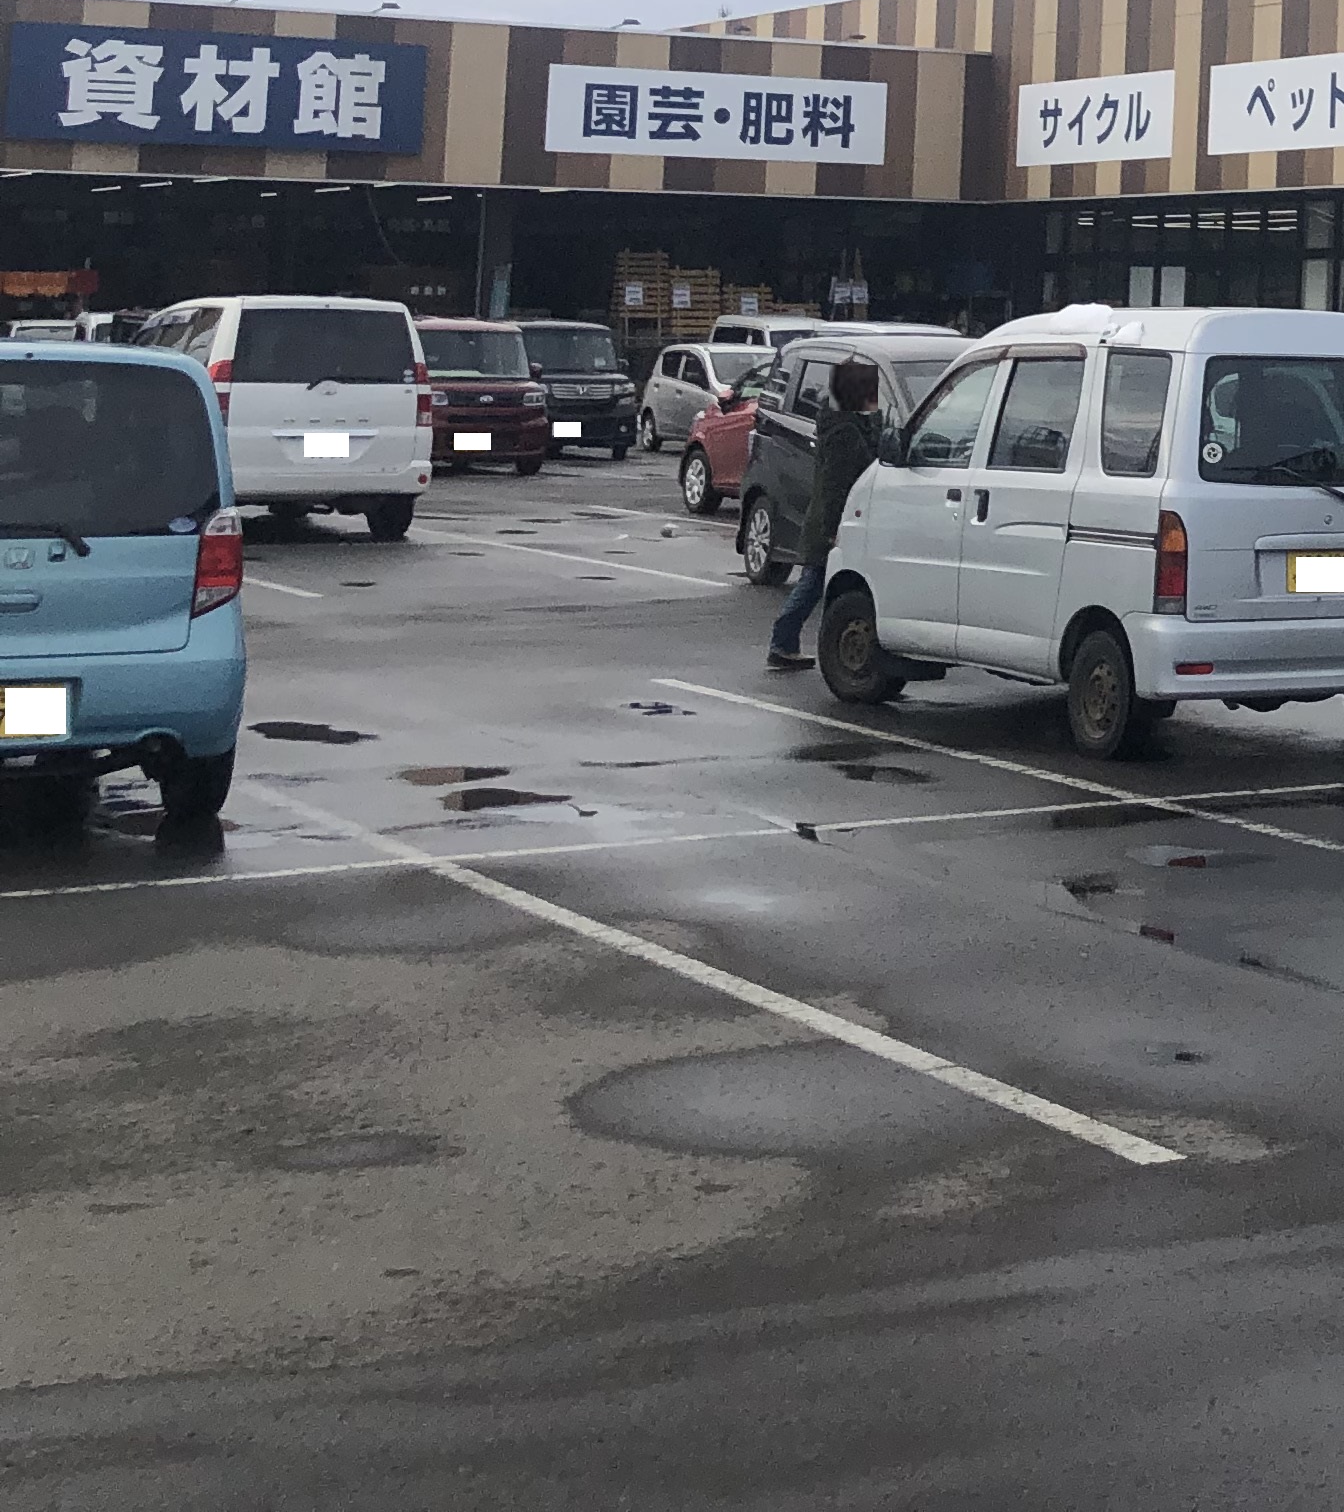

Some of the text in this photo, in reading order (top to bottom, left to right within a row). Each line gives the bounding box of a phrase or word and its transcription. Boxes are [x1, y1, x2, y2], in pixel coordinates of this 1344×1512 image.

[58, 38, 387, 141] 資材館
[581, 81, 855, 150] 園芸・肥料
[1039, 90, 1152, 149] サイクル
